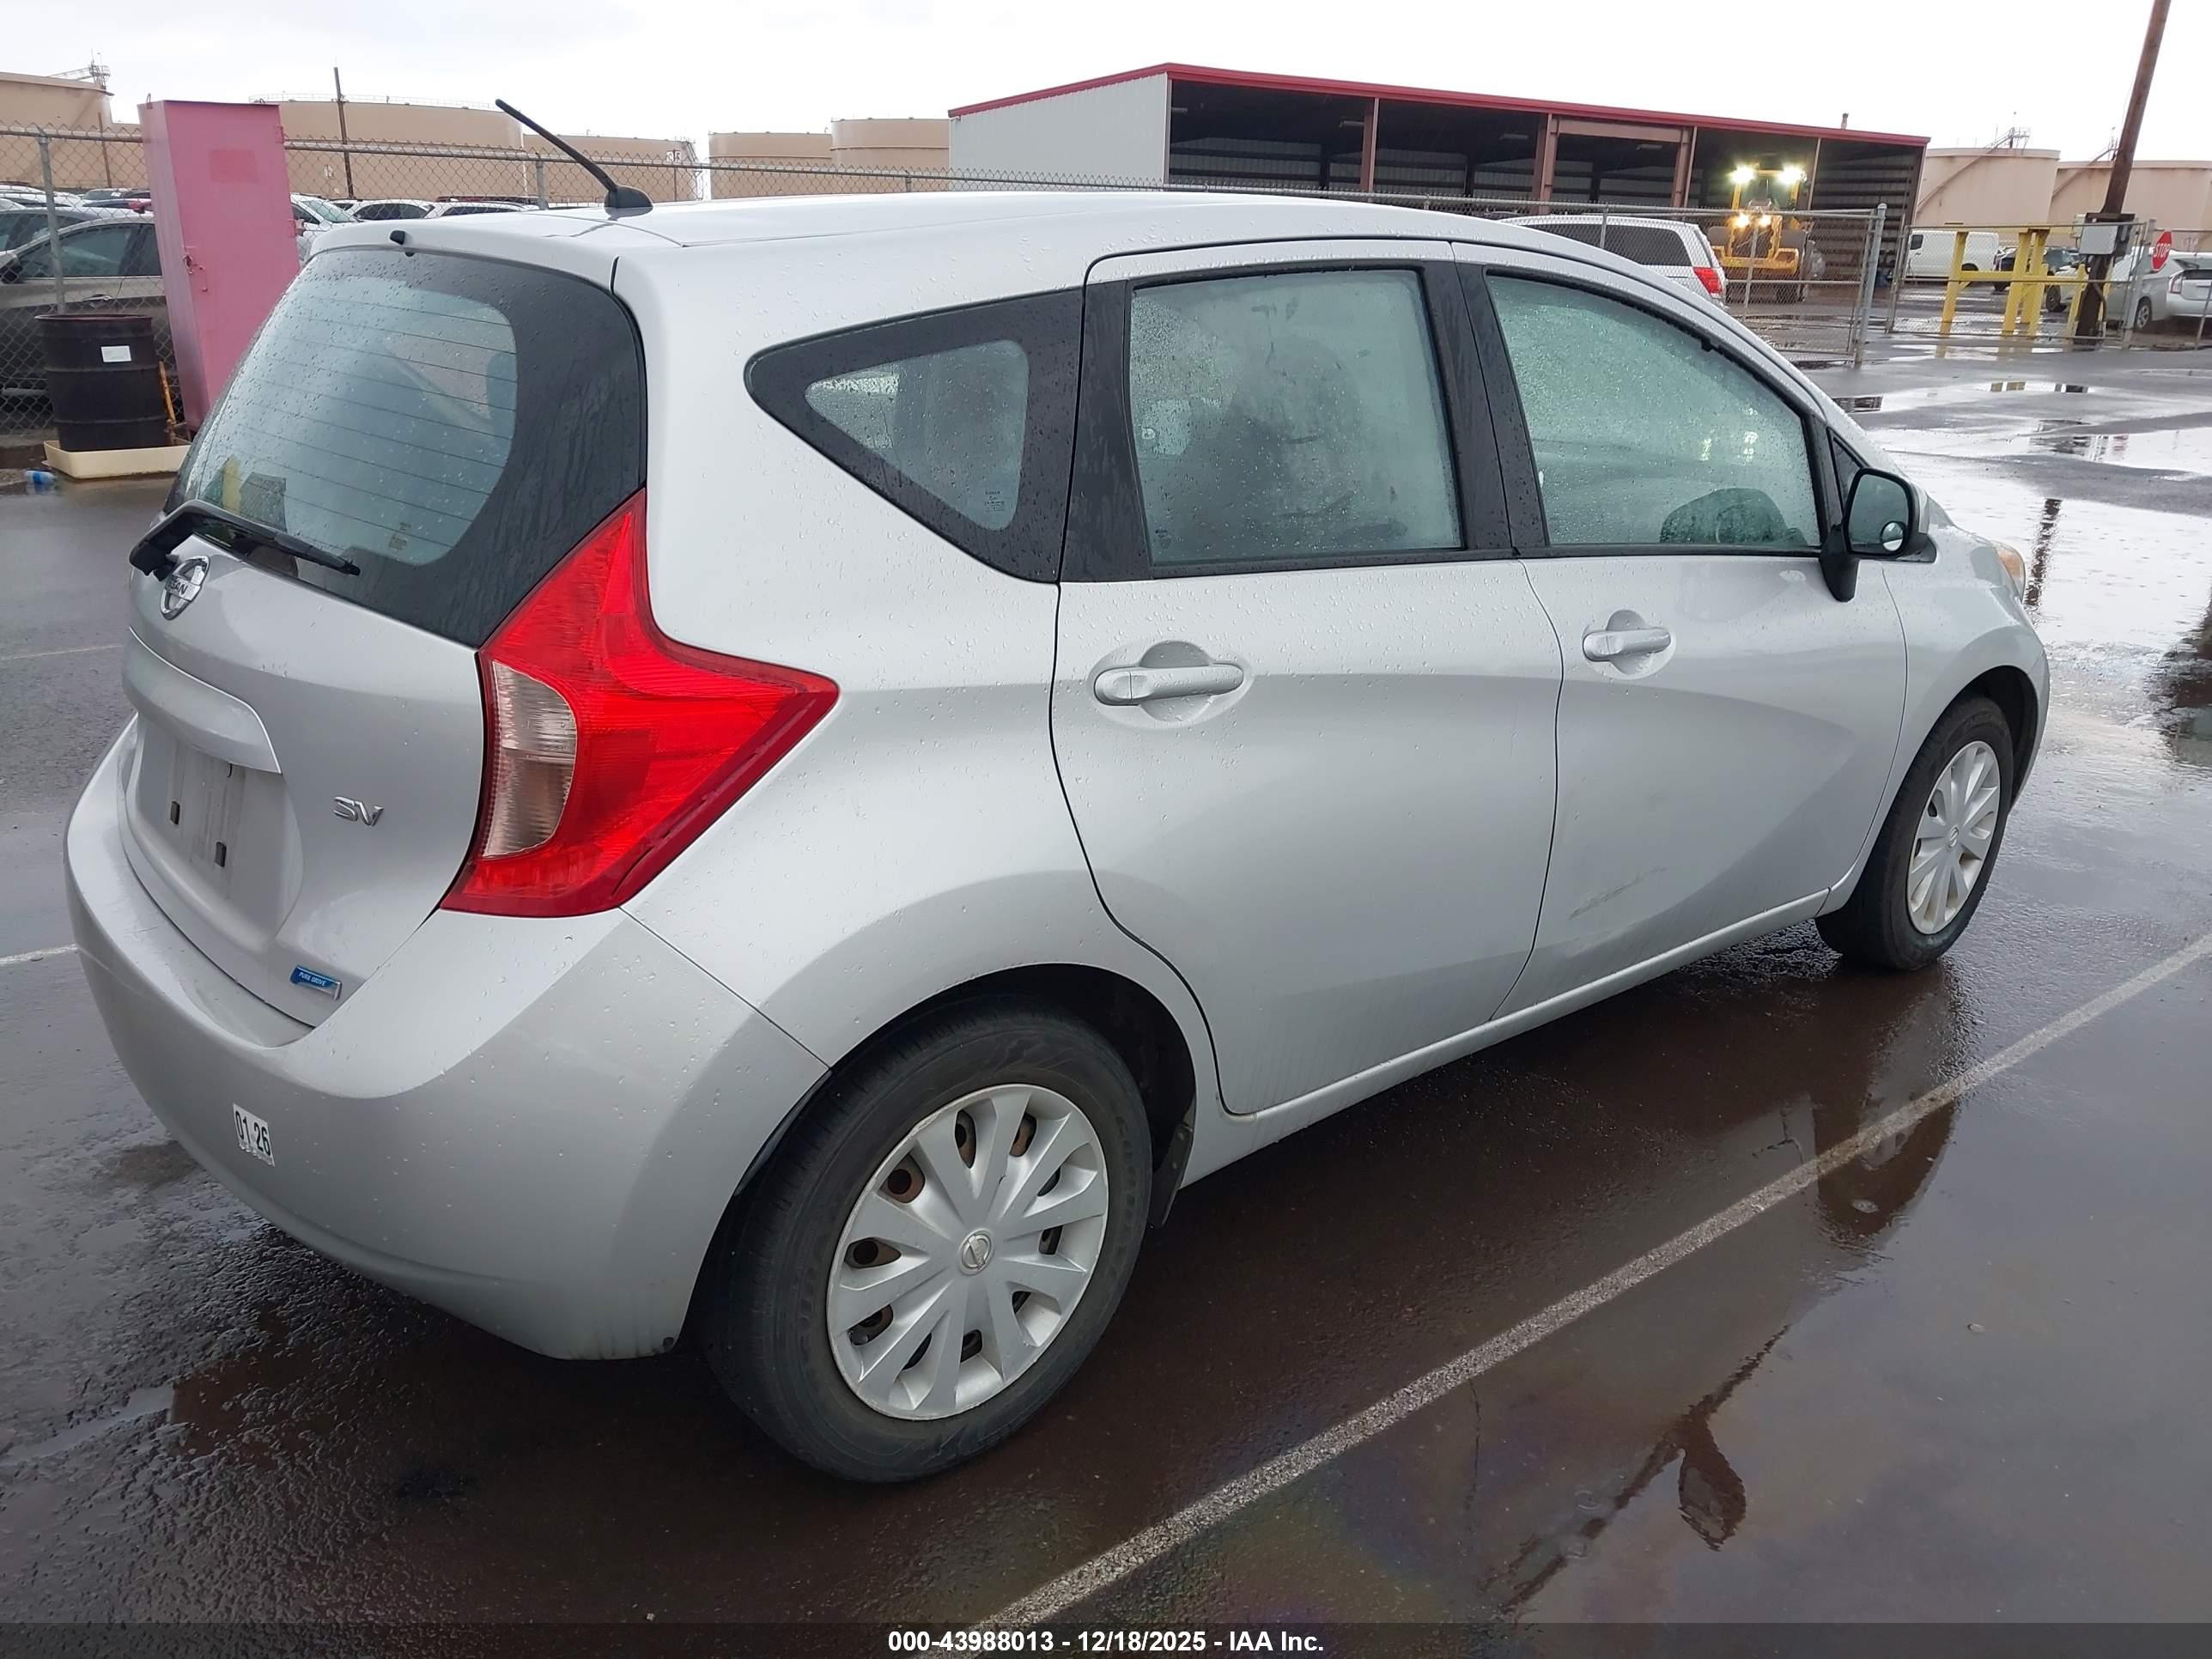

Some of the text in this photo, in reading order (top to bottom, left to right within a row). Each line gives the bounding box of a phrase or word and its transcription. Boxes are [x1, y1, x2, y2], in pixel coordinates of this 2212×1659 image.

[2154, 243, 2170, 258] STOP
[332, 795, 384, 827] SV
[311, 976, 326, 986] DRIVE
[253, 1121, 270, 1156] 26
